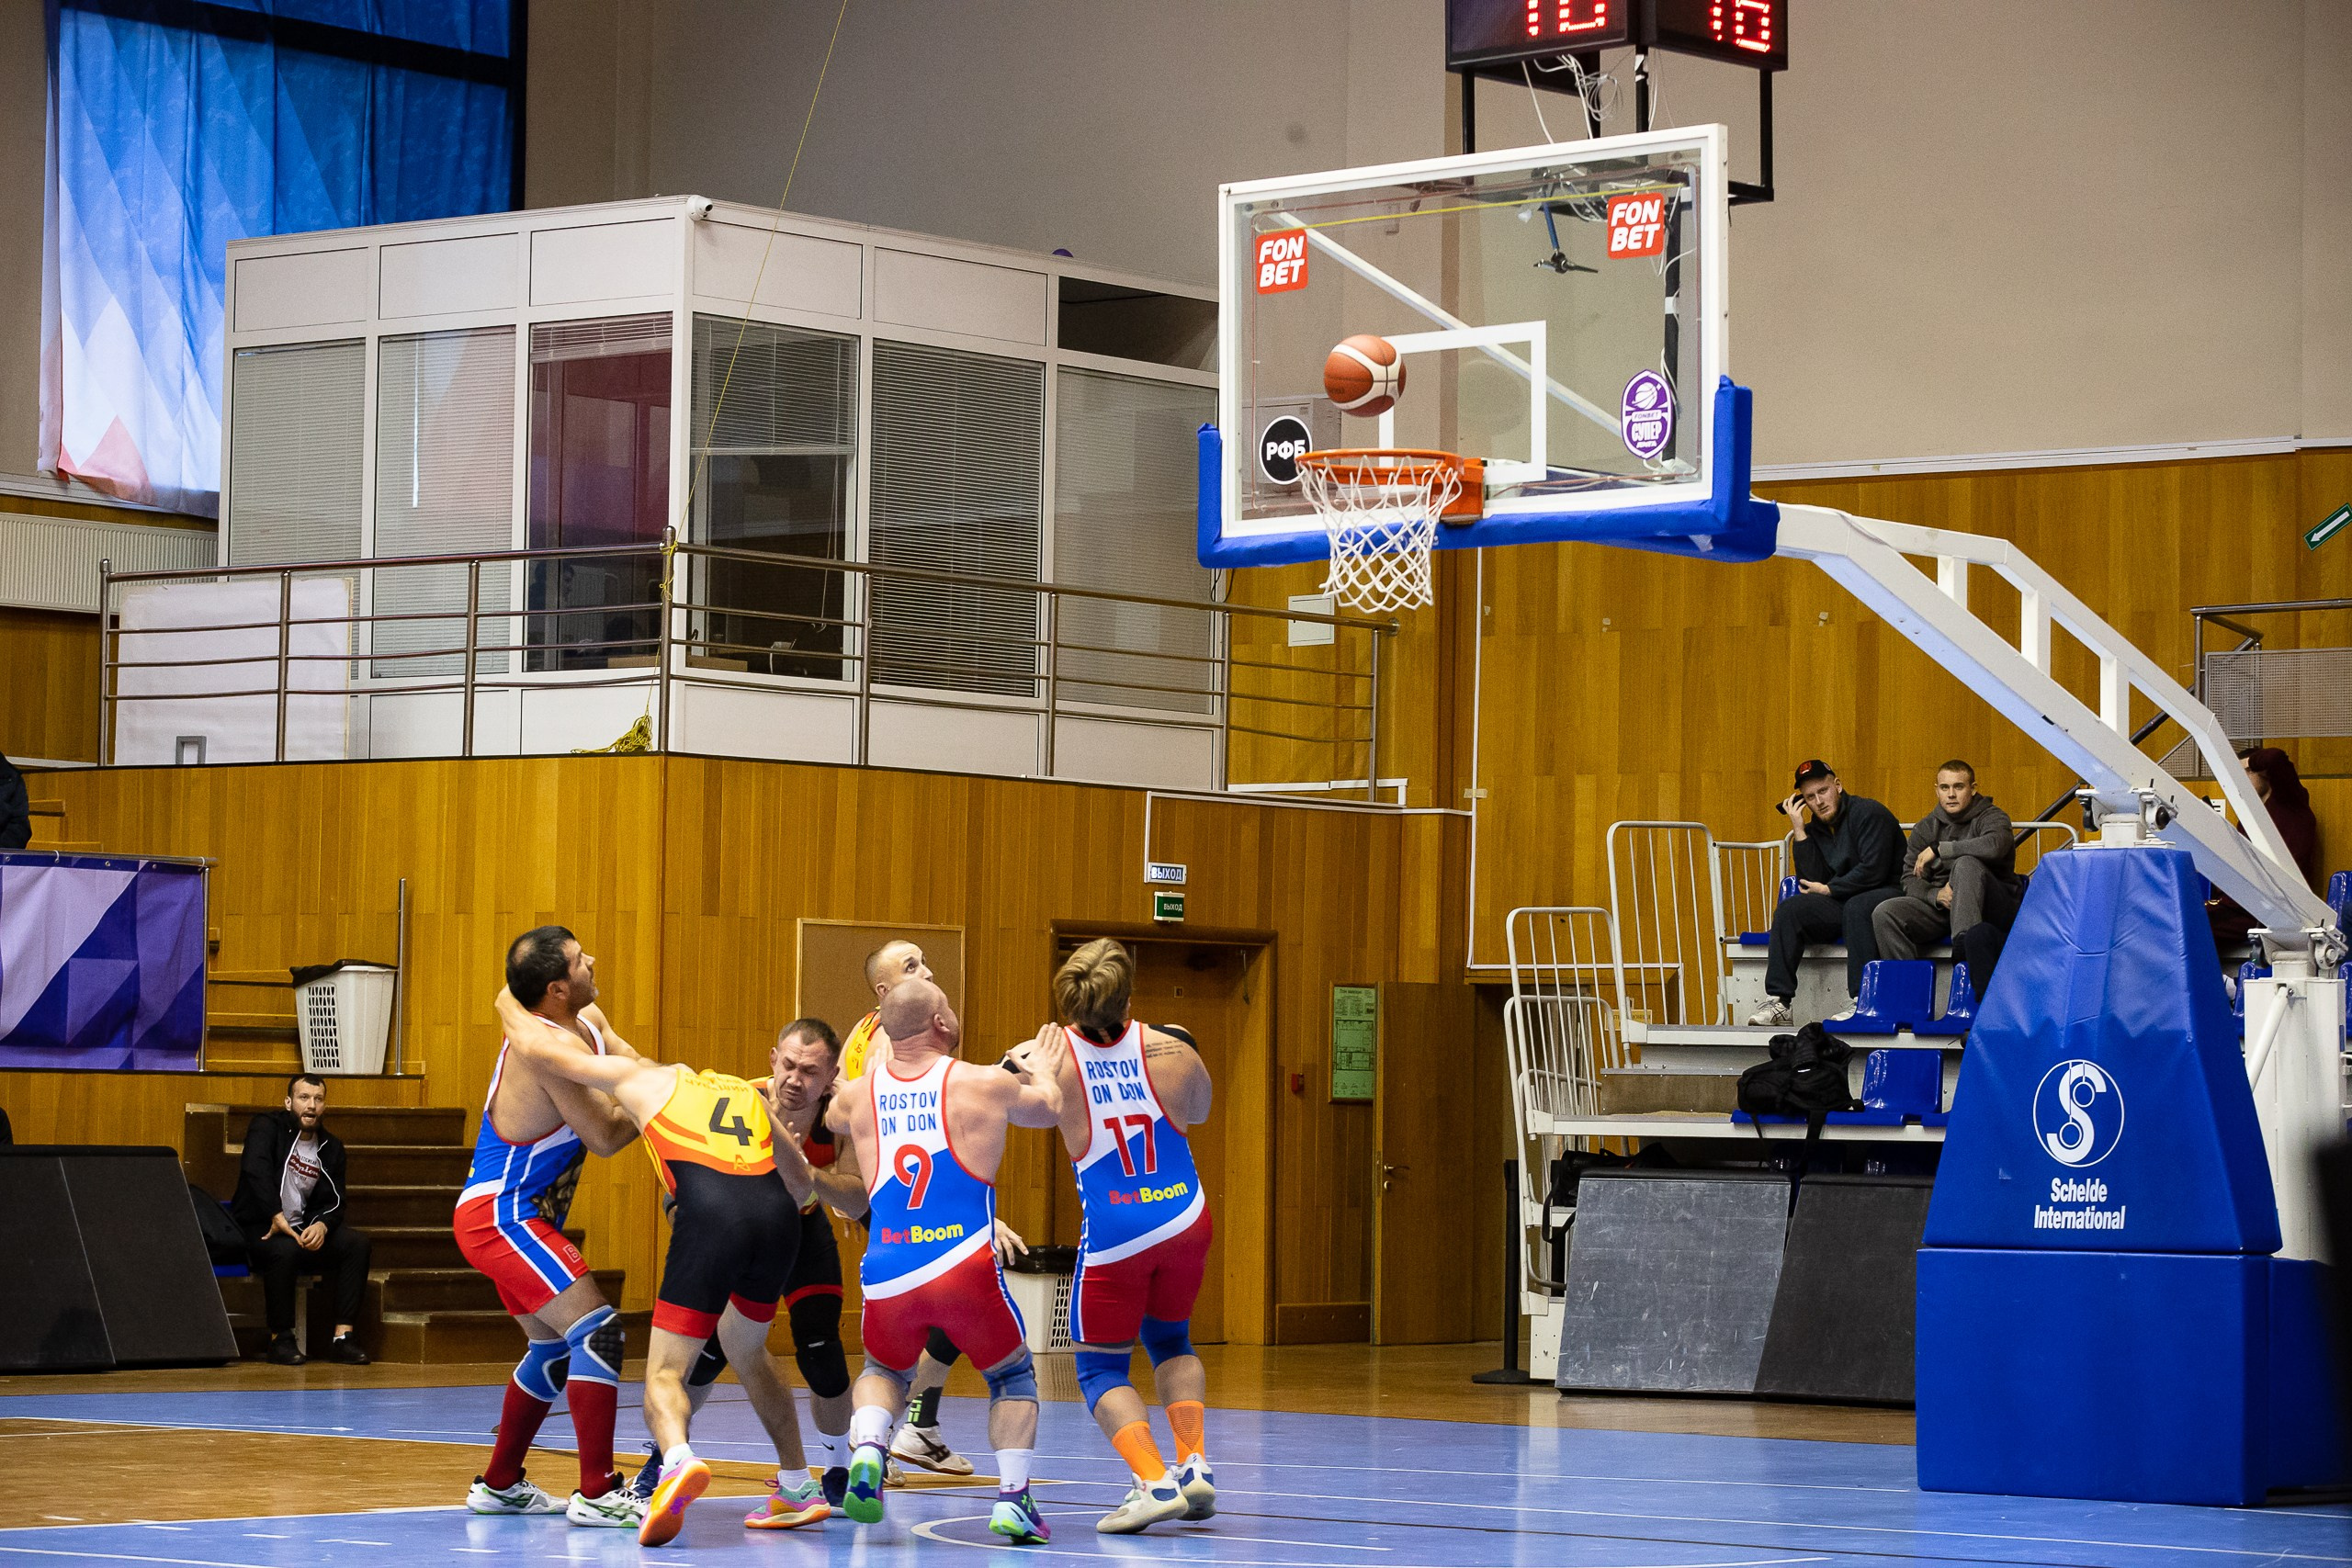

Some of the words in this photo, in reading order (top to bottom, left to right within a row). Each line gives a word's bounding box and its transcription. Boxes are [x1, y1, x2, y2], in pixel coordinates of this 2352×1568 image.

[1611, 198, 1661, 227] FON
[1259, 235, 1305, 264] FON
[1611, 223, 1661, 253] BET
[1260, 258, 1306, 288] BET
[1632, 422, 1662, 442] СУПЕР
[1266, 439, 1306, 460] РФБ
[1150, 866, 1182, 881] ВЫХОД
[1163, 903, 1183, 912] ВЫХОД
[1085, 1058, 1139, 1080] ROSTOV
[879, 1090, 937, 1111] ROSTOV
[1091, 1084, 1113, 1105] ON
[1117, 1081, 1148, 1100] DON
[708, 1097, 754, 1146] 4
[881, 1116, 897, 1136] ON
[908, 1112, 937, 1132] DON
[1102, 1113, 1158, 1178] 17
[894, 1144, 933, 1211] 9
[2051, 1177, 2108, 1202] Schelde
[1108, 1181, 1189, 1205] BetBoom
[2033, 1204, 2126, 1230] International
[881, 1224, 964, 1245] BetBoom
